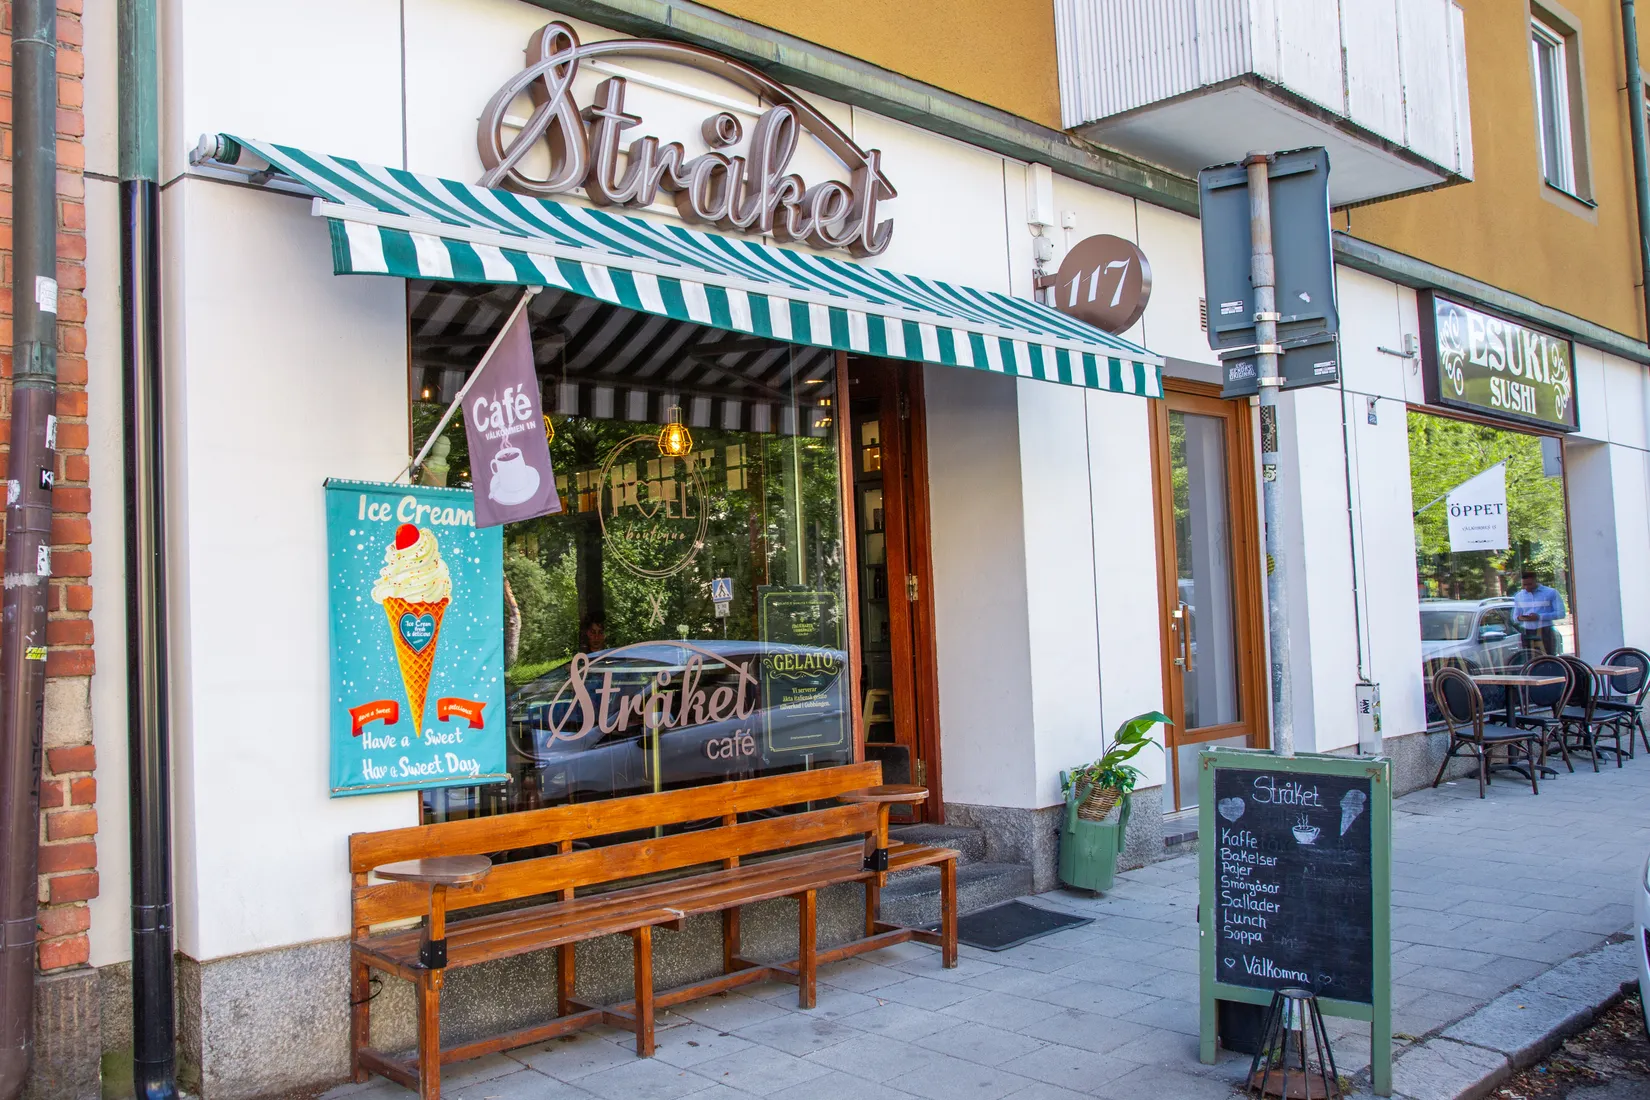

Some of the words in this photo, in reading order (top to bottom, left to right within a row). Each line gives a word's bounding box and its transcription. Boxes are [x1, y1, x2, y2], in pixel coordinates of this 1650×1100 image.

[477, 21, 898, 258] Stråket
[1063, 257, 1131, 308] 117
[1466, 311, 1551, 384] ESUKI
[473, 383, 533, 433] Café
[1490, 376, 1537, 415] SUSHI
[526, 421, 536, 430] IN
[358, 494, 392, 522] Ice
[396, 495, 476, 527] Cream
[1450, 502, 1503, 517] ÖPPET
[773, 651, 833, 672] GELATO
[547, 639, 758, 748] Stråket
[362, 731, 397, 750] Have
[401, 736, 410, 747] a
[424, 727, 463, 746] Sweet
[706, 729, 755, 760] café
[390, 766, 398, 778] a
[399, 754, 444, 778] Sweet
[445, 752, 481, 779] Day
[1252, 776, 1321, 807] Stråket
[1222, 827, 1258, 849] Kaffe
[1220, 848, 1278, 866] Bakelser
[1222, 862, 1252, 880] Pajer
[1221, 876, 1280, 896] Smörgåsar
[1221, 890, 1280, 913] Sallader
[1224, 908, 1267, 929] Lunch
[1224, 925, 1263, 945] Soppa
[1243, 954, 1311, 984] Välkomna
